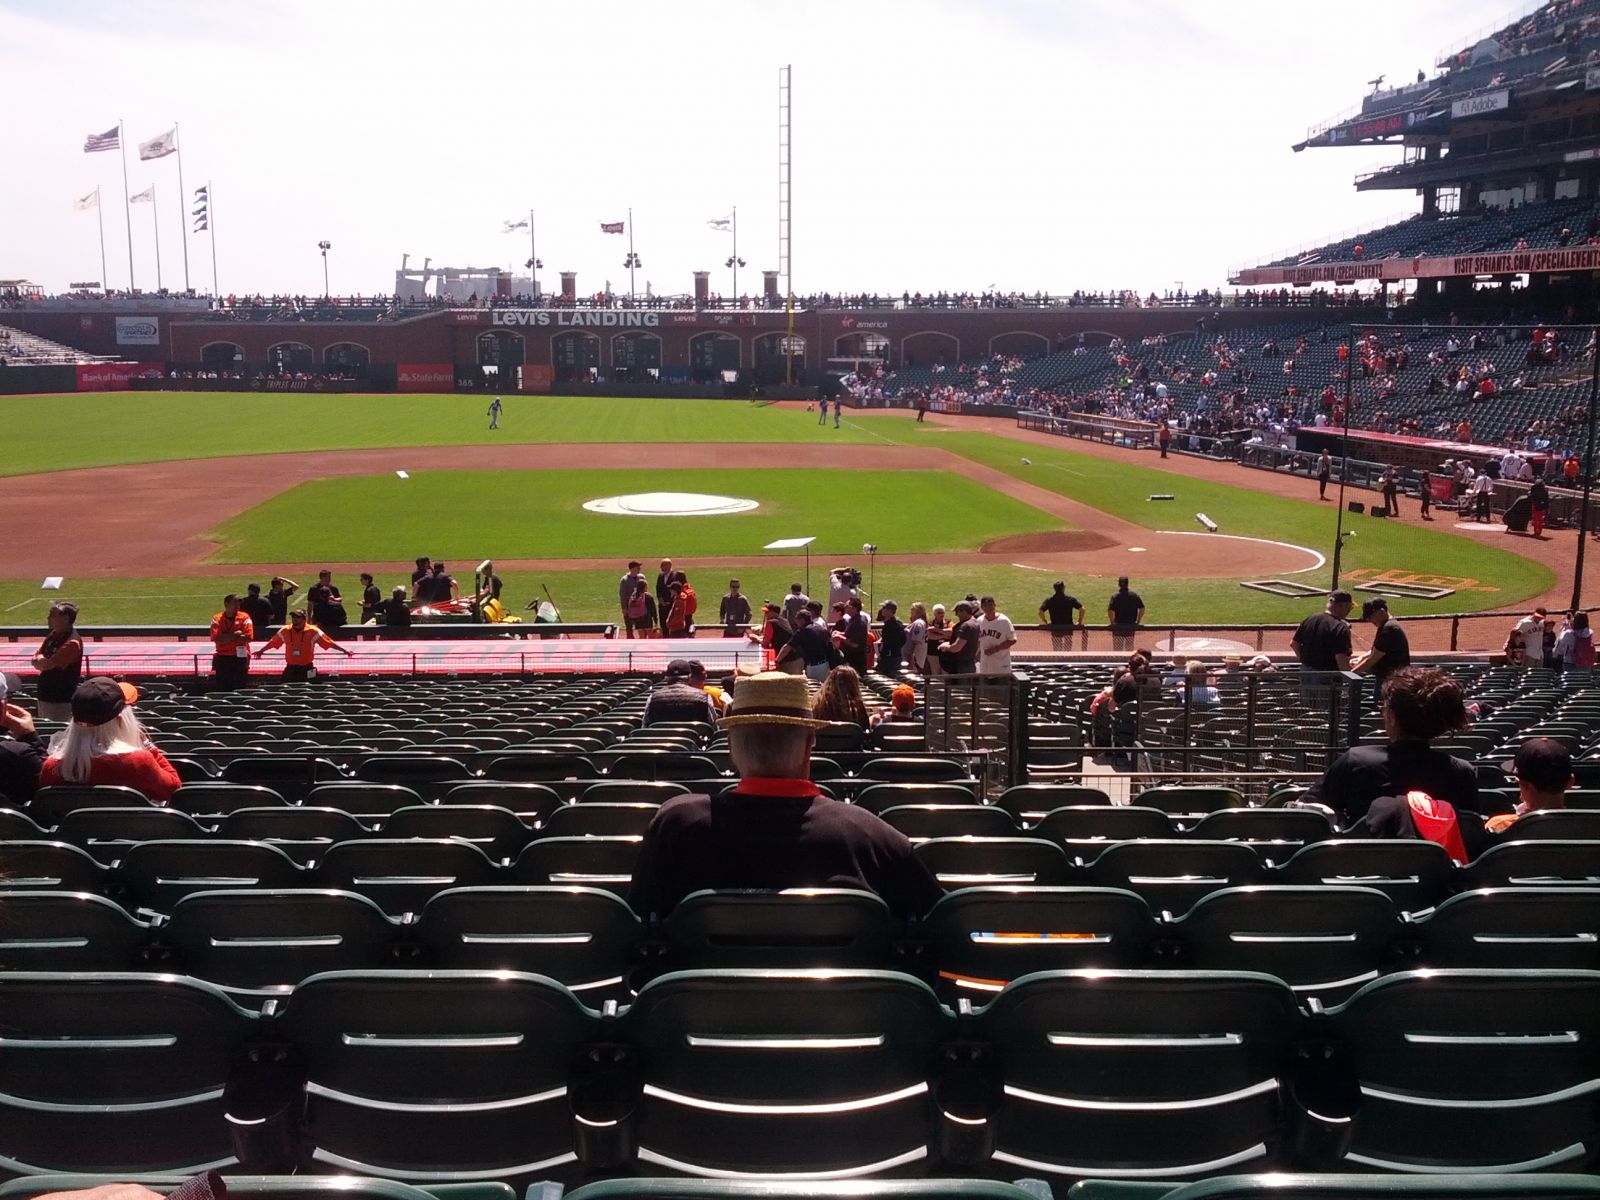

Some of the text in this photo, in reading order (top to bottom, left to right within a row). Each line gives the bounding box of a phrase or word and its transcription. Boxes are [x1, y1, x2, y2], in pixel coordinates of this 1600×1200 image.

[1470, 96, 1499, 112] Adobe
[1454, 257, 1473, 274] VISIT
[558, 312, 659, 327] LANDING
[856, 320, 888, 328] america
[82, 373, 102, 382] Bank
[103, 373, 111, 381] of
[412, 373, 454, 382] State Farm
[458, 379, 473, 387] 365
[979, 628, 1002, 640] ANTS
